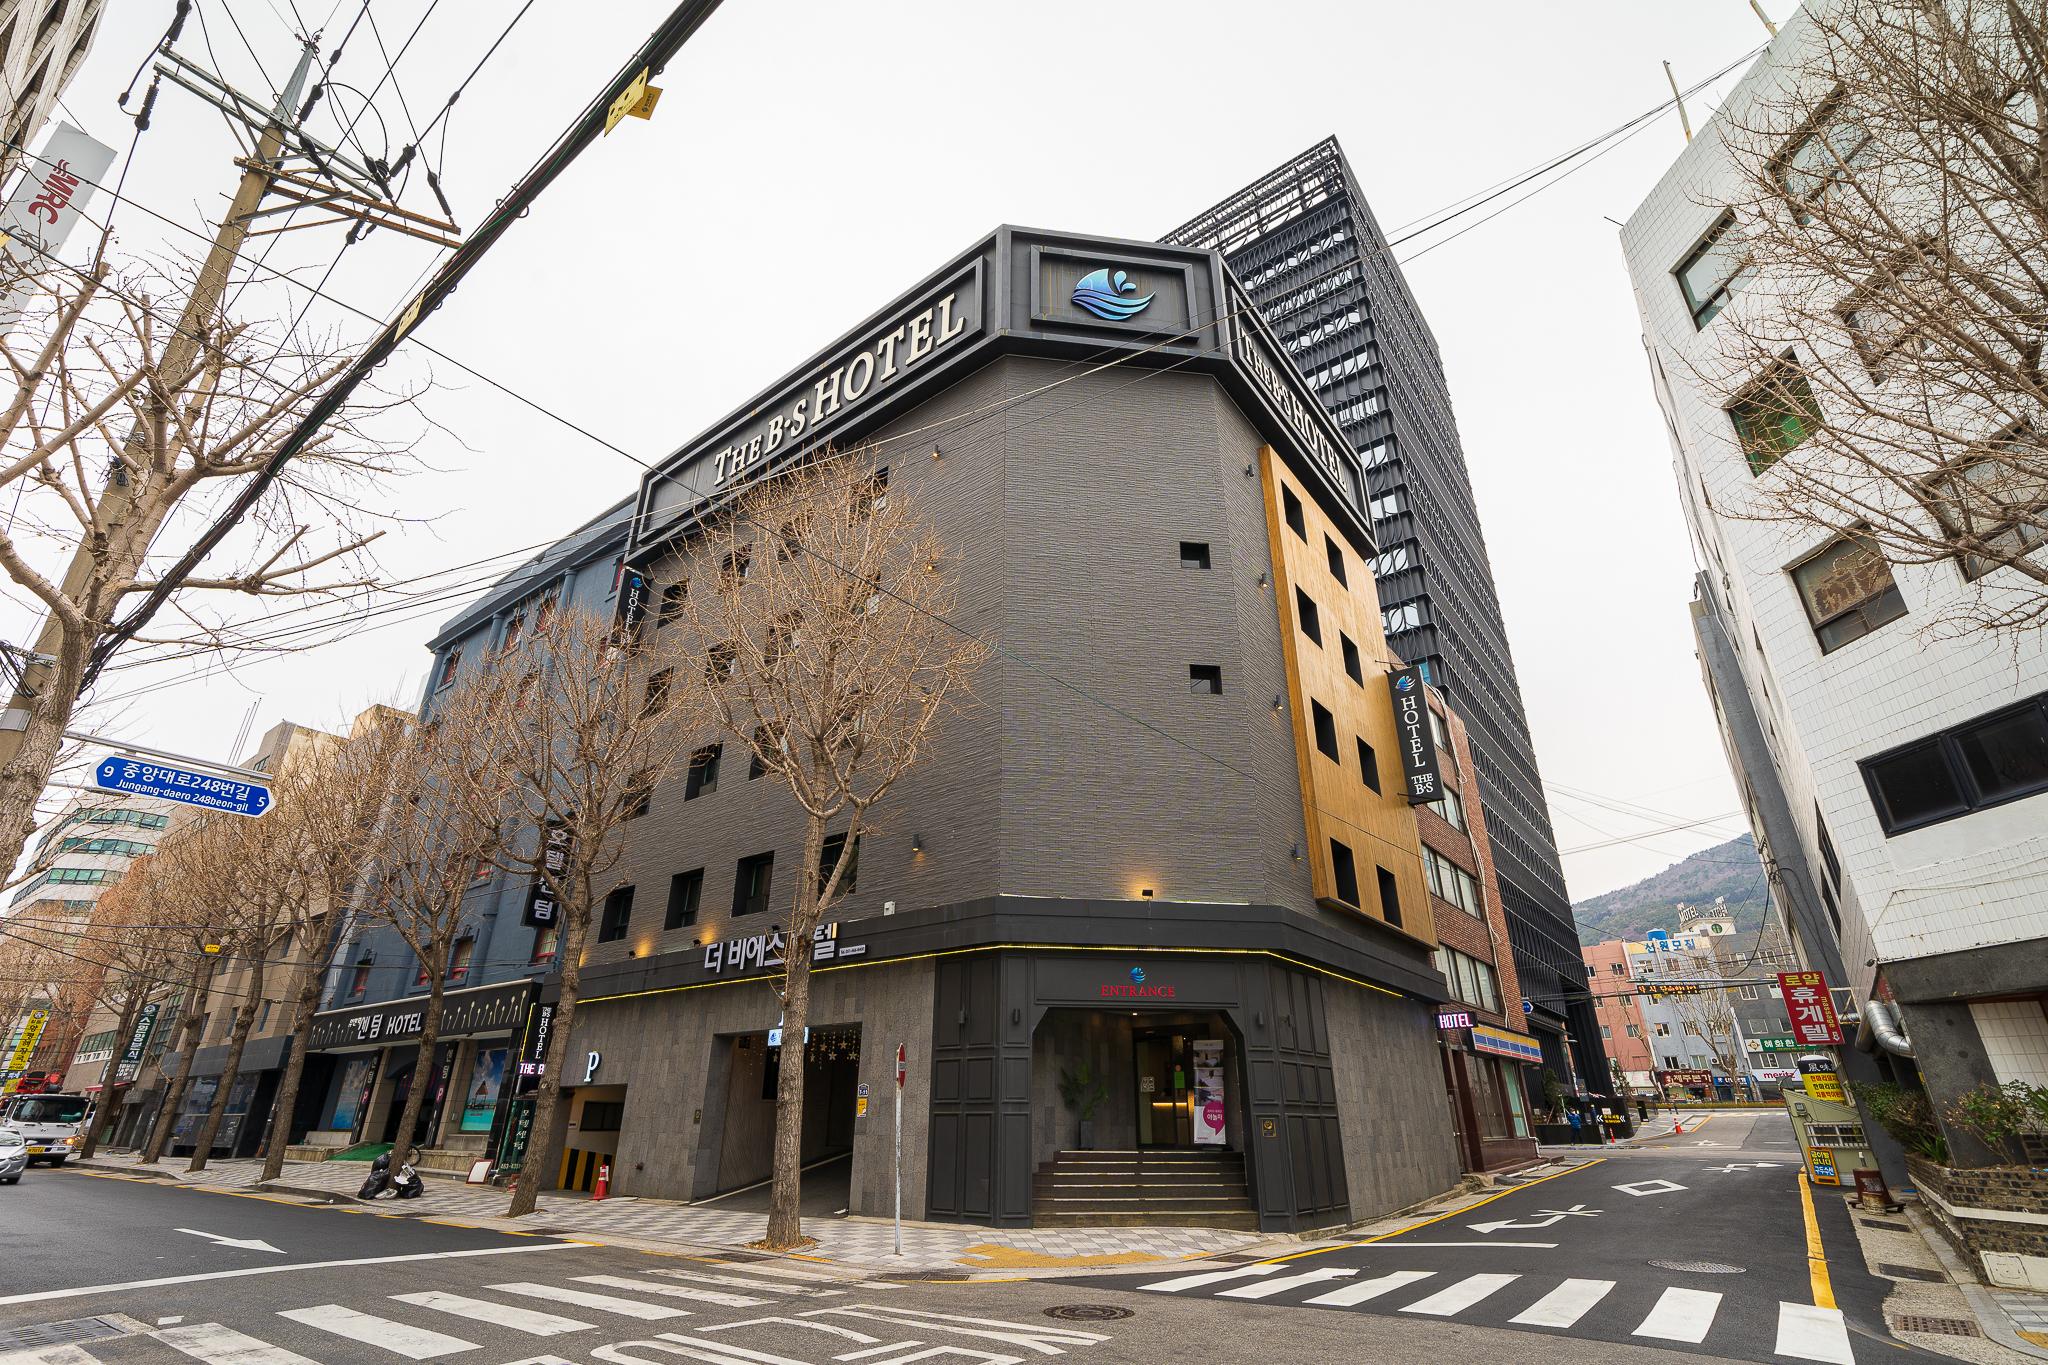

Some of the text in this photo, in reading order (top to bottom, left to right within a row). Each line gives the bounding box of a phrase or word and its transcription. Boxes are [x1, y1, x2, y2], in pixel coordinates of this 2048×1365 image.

[713, 434, 763, 487] THE
[810, 293, 965, 427] HOTEL
[1241, 327, 1272, 387] THE
[1289, 389, 1347, 488] HOTEL
[1400, 695, 1427, 768] HOTEL
[103, 762, 250, 801] 9 중앙대로248번길
[116, 779, 266, 812] Jungang-daero 248beon-gil 5
[1411, 773, 1434, 785] THE
[1101, 984, 1176, 998] ENTRANCE
[1785, 973, 1820, 986] 로얄
[385, 1012, 422, 1035] HOTEL
[1438, 1012, 1474, 1029] HOTEL
[1791, 987, 1831, 1042] 휴게텔
[535, 1018, 550, 1059] HOTEL
[520, 1063, 536, 1075] THE
[584, 1050, 601, 1083] P
[1763, 1070, 1796, 1079] meritz
